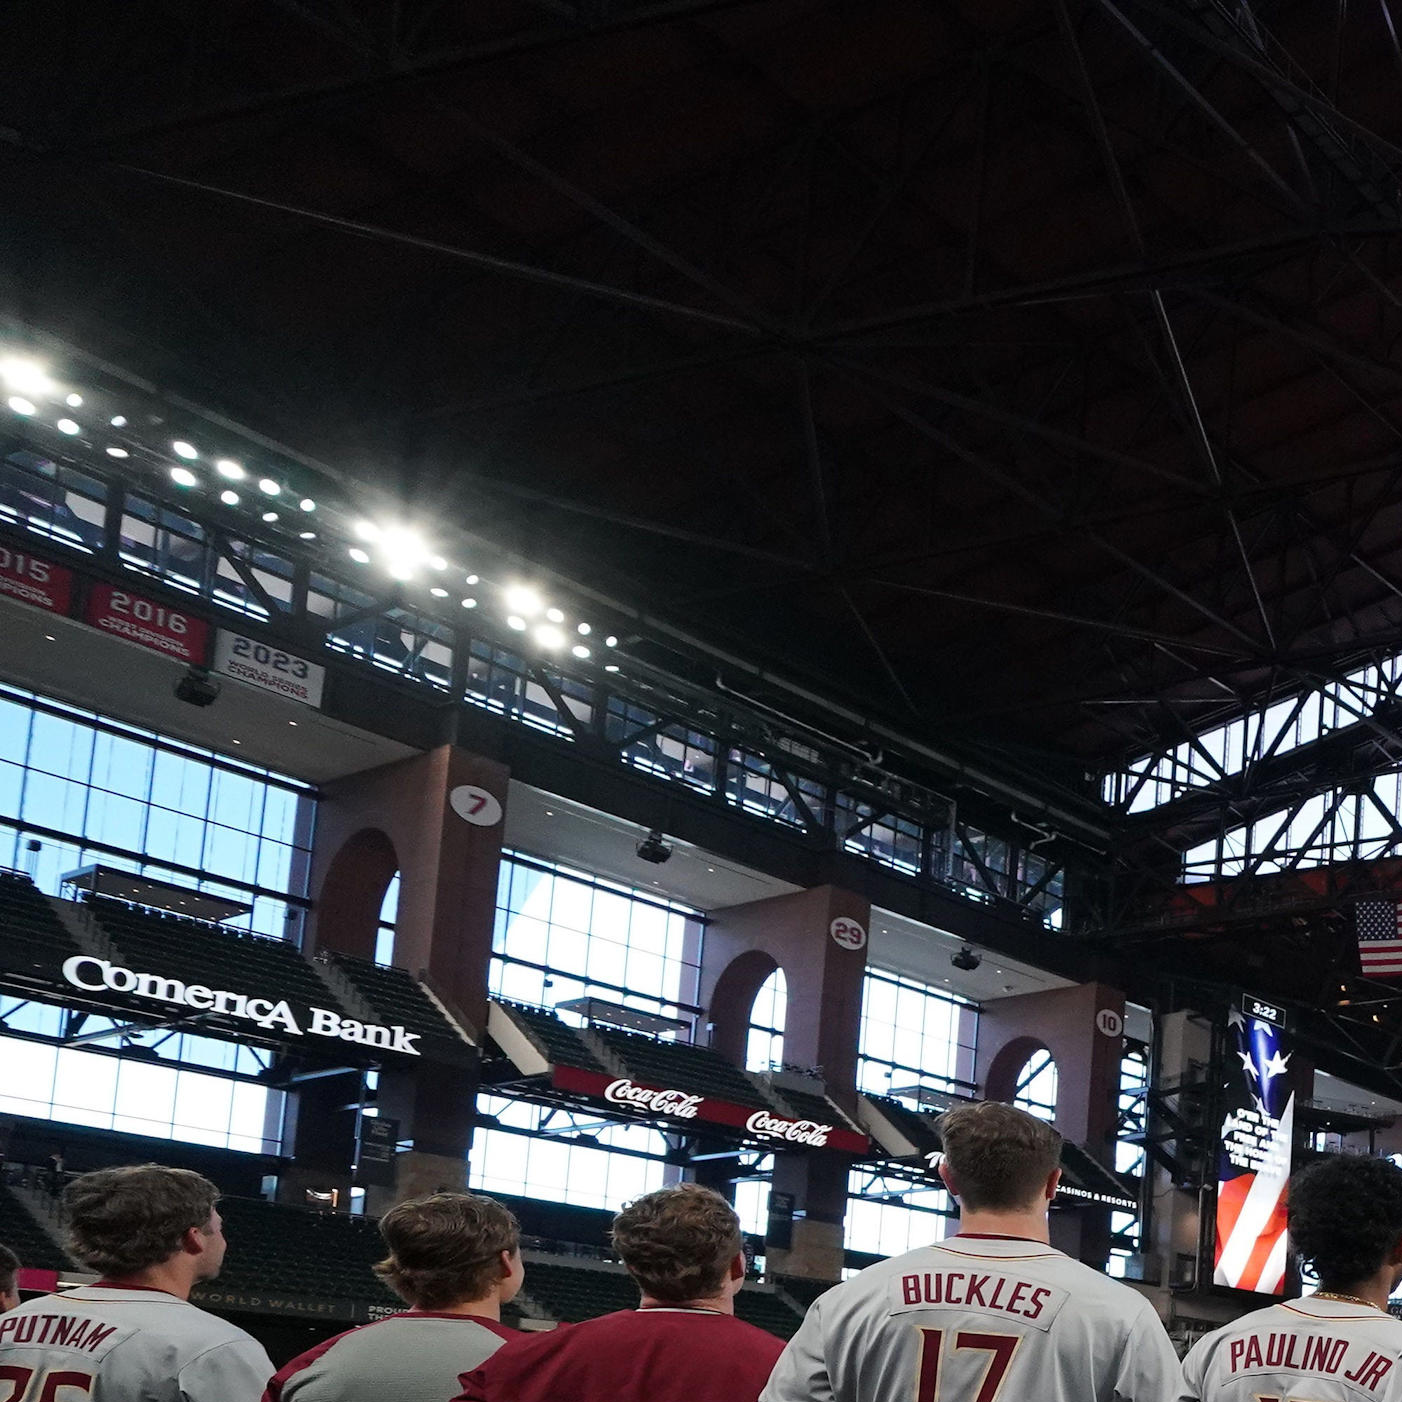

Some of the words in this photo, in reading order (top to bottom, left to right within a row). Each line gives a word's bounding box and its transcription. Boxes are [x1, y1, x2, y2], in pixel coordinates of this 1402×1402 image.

[110, 590, 188, 634] 2016
[98, 617, 191, 657] CHAMPIONS
[228, 660, 269, 678] WORLD
[232, 637, 309, 679] 2023
[228, 665, 310, 699] CHAMPIONS
[465, 793, 488, 815] 7
[834, 922, 862, 945] 29
[1101, 1013, 1116, 1032] 10
[1252, 1002, 1277, 1020] 3:22
[306, 1007, 421, 1056] Bank
[604, 1079, 704, 1119] Coca-Cola
[745, 1110, 833, 1147] Coca-Cola
[1237, 1108, 1259, 1123] OVER
[1262, 1115, 1279, 1129] THE
[1254, 1125, 1268, 1136] OF
[1224, 1140, 1244, 1154] THE
[1234, 1131, 1258, 1146] FREE
[1229, 1153, 1249, 1168] THE
[1056, 1184, 1093, 1199] CASINOS
[1101, 1194, 1138, 1209] RESORTS
[191, 1291, 260, 1306] WORLD
[268, 1298, 336, 1314] WALLET
[902, 1273, 1052, 1320] BUCKLES
[0, 1314, 118, 1352] PUTNAM
[1230, 1333, 1350, 1375] PAULINO
[1344, 1350, 1393, 1392] JR
